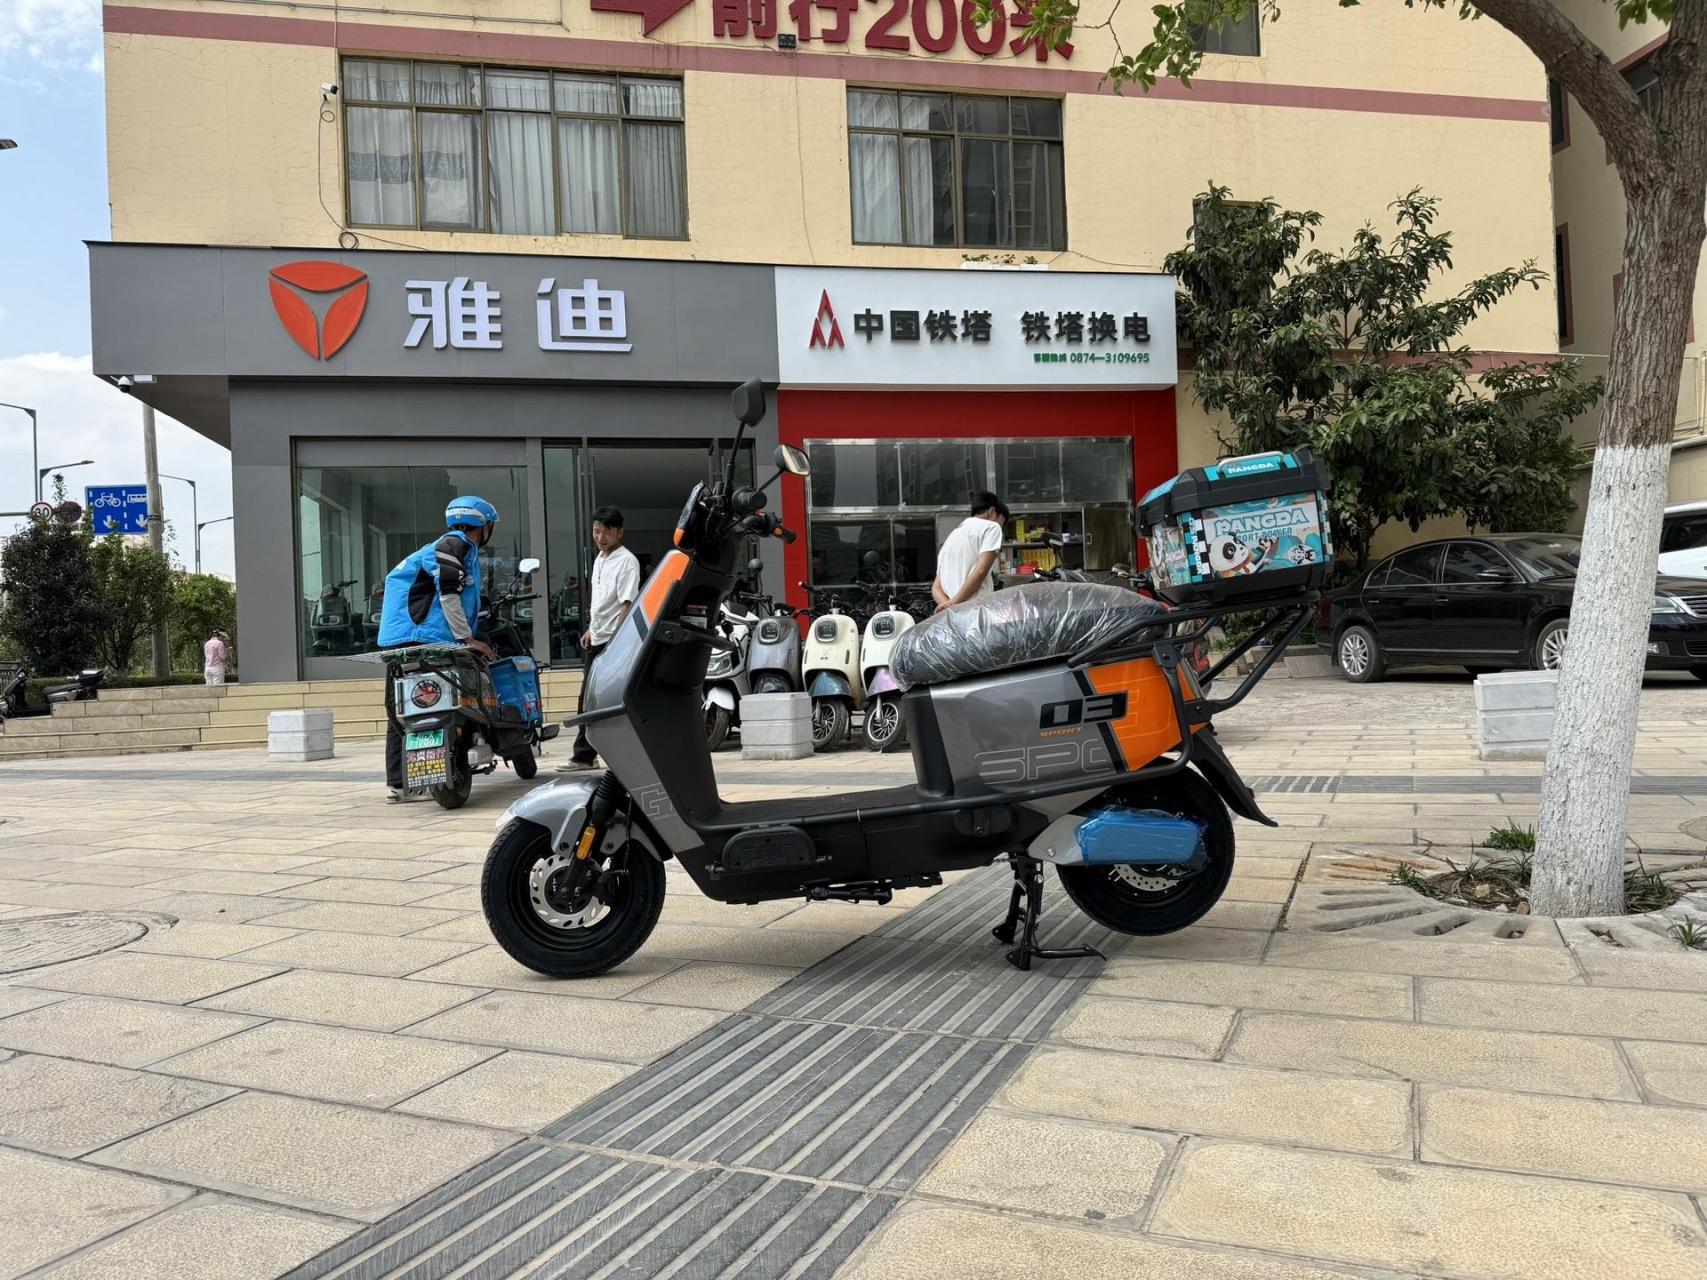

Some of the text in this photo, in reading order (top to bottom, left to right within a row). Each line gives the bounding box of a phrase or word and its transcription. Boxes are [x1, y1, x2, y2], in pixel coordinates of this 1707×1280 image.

[402, 276, 633, 353] 雅迪
[854, 308, 1152, 344] 中国铁塔 铁塔换电
[1228, 462, 1274, 474] PANGDA
[1214, 508, 1310, 537] PANGDA
[1039, 692, 1127, 729] 03
